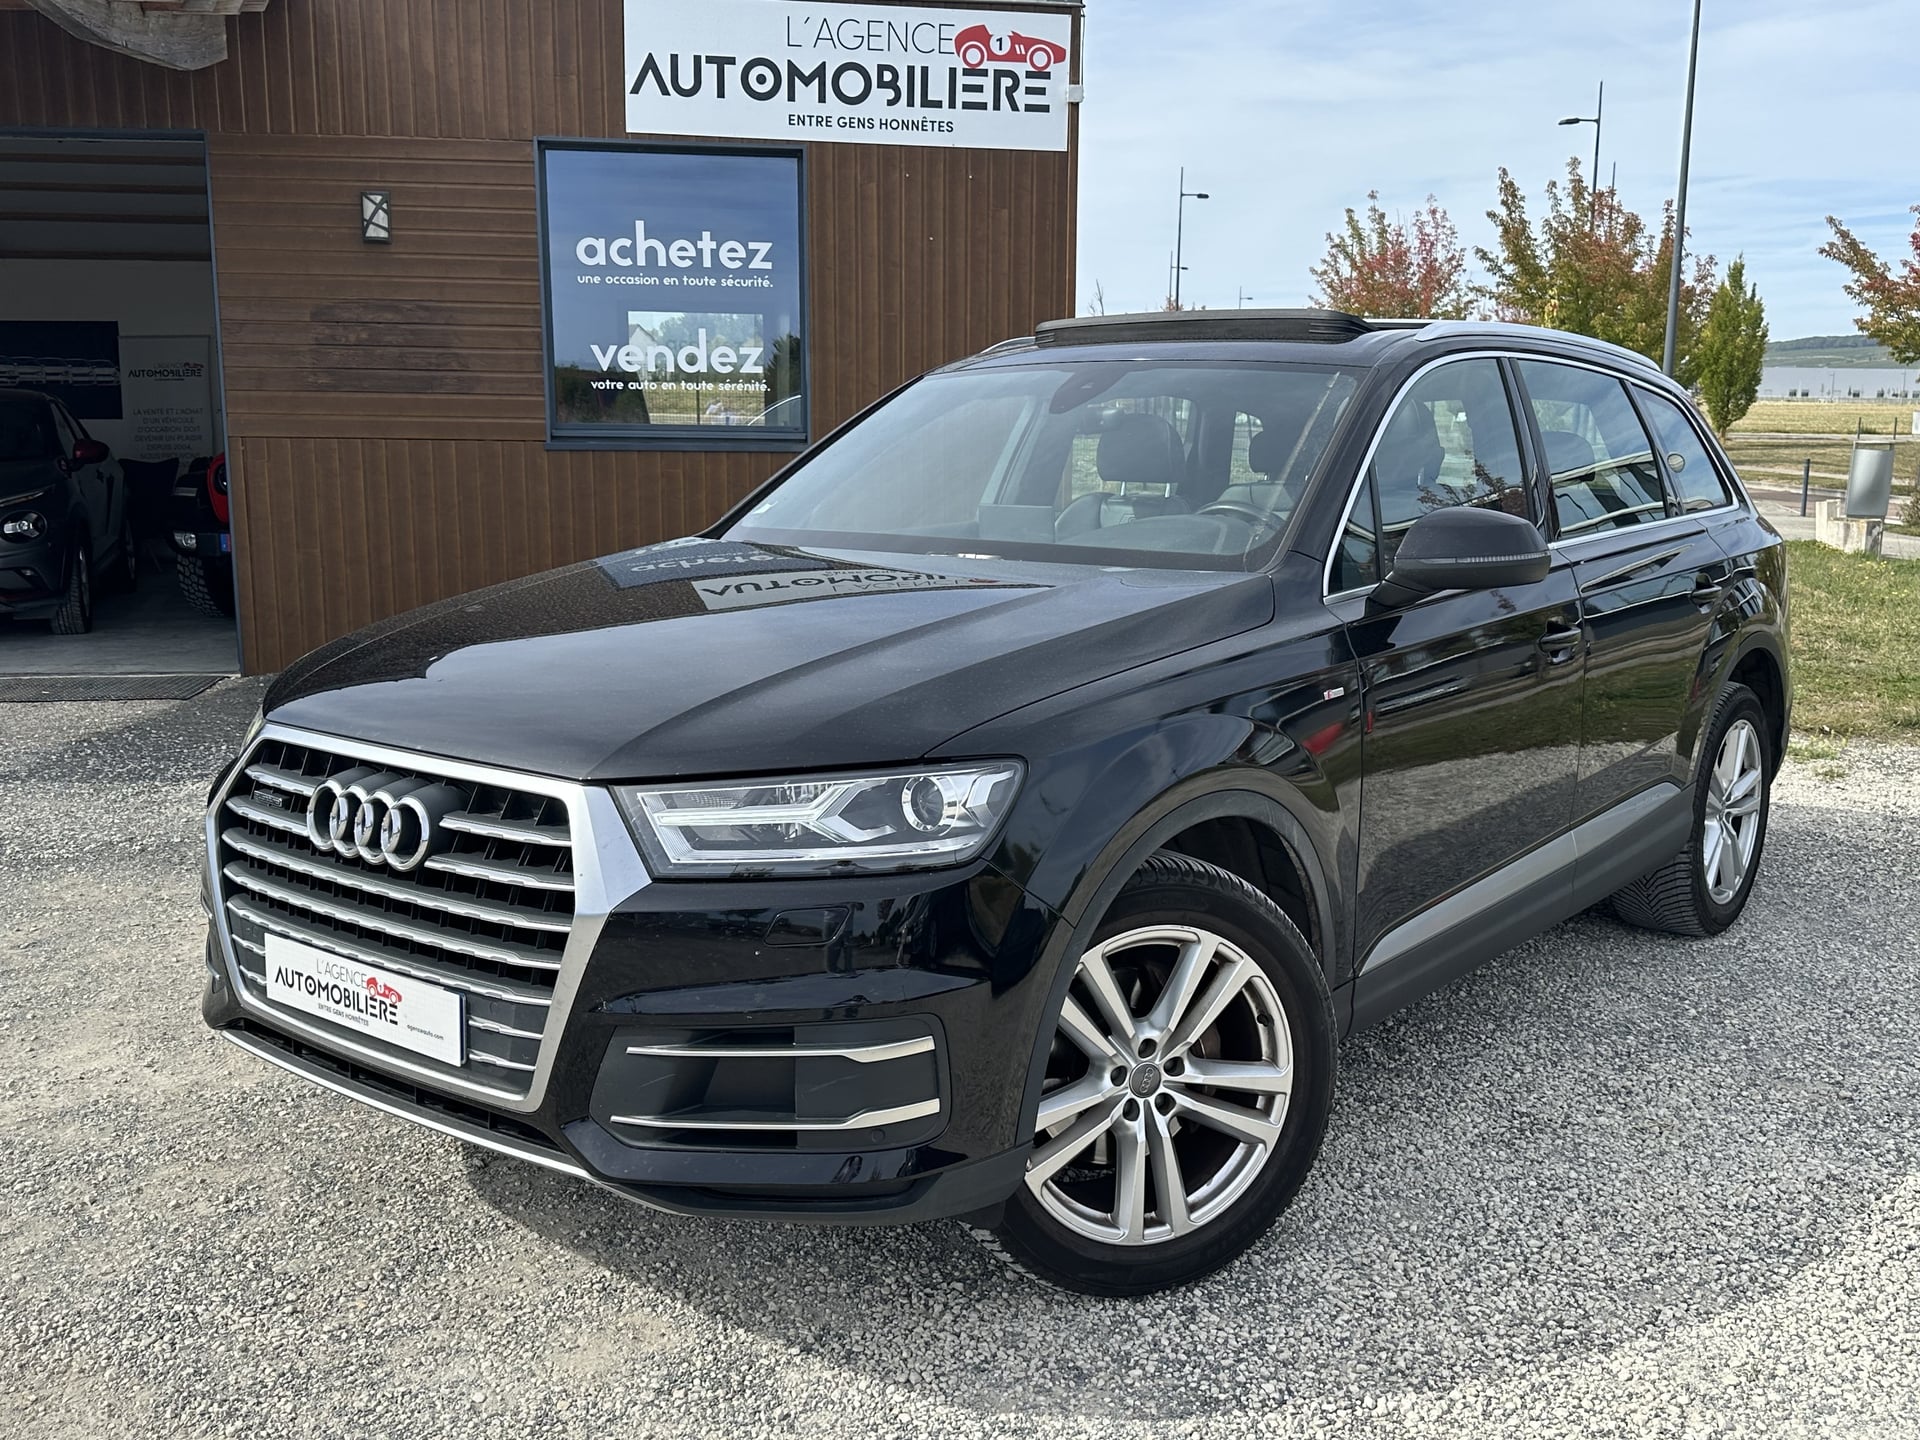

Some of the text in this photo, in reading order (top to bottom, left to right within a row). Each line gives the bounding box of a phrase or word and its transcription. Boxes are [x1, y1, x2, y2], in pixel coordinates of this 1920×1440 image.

[786, 15, 957, 55] L'AGENCE
[995, 37, 1003, 51] 1
[788, 113, 954, 133] ENTRE GENS HONNÊTES
[576, 220, 773, 270] achetez
[577, 272, 774, 288] une occasion en toute sécurité.
[590, 328, 764, 374] vendez
[590, 378, 771, 393] votre auto en toute sérénité.
[316, 959, 367, 990] L'AGENCE
